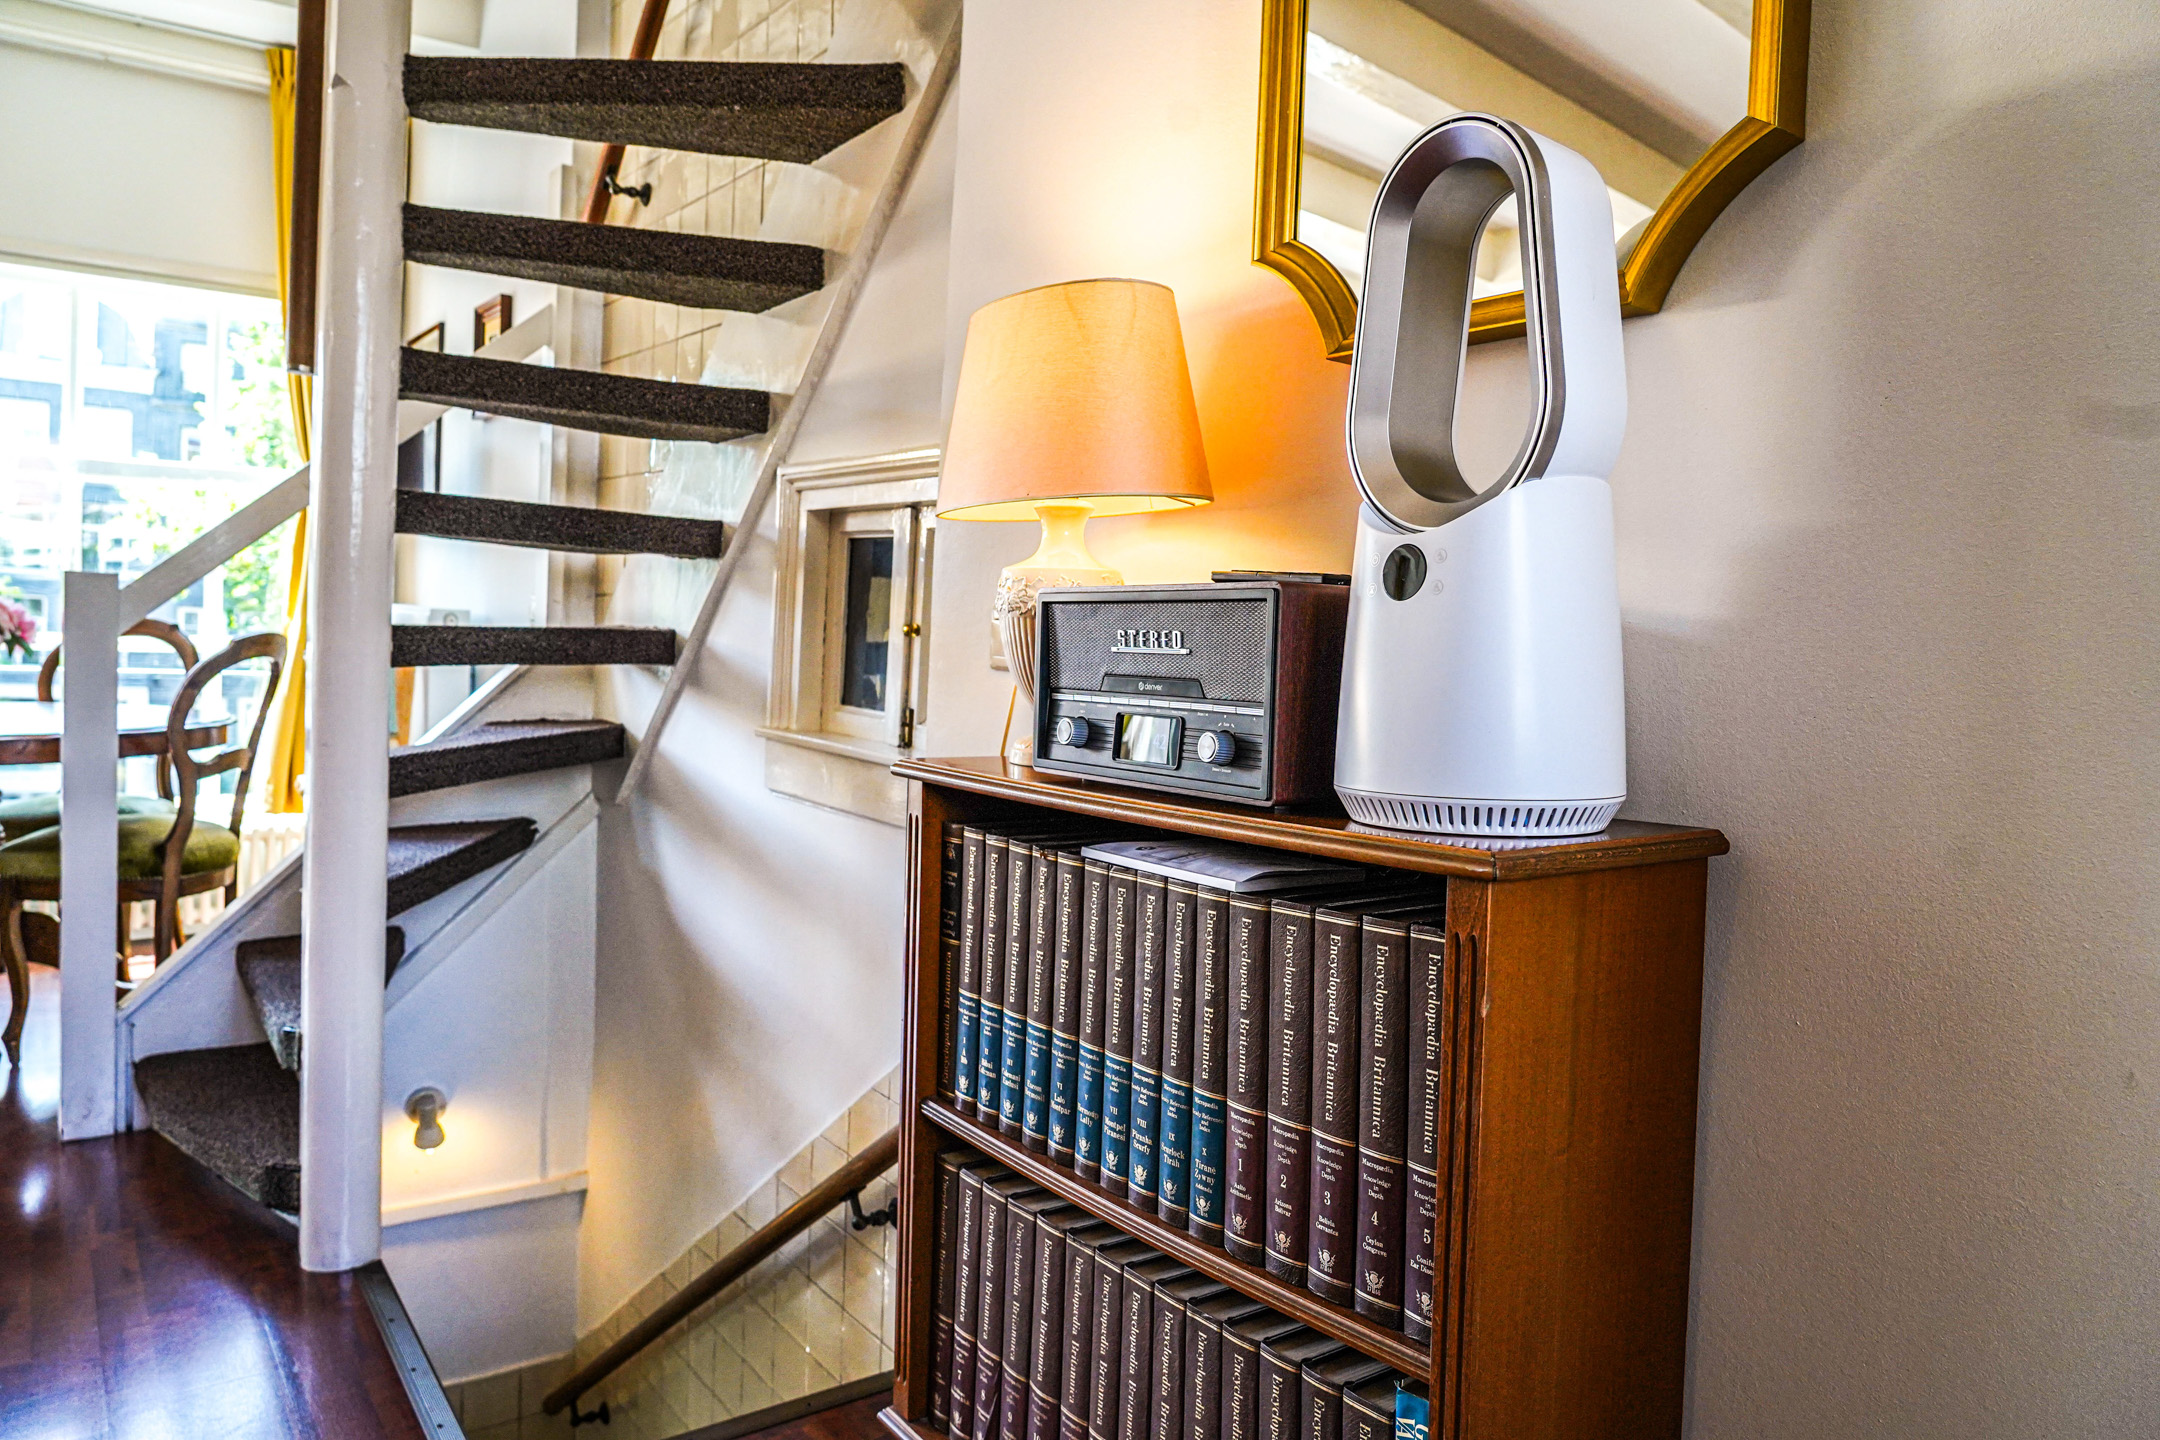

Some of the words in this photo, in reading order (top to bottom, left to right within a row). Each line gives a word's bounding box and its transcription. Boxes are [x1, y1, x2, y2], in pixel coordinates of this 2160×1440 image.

[1117, 629, 1183, 649] STEREO
[1144, 682, 1163, 691] denver
[964, 923, 974, 983] Britannica
[985, 932, 996, 993] Britannica
[1009, 941, 1020, 1003] Britannica
[1033, 949, 1045, 1013] Britannica
[1058, 959, 1069, 1023] Britannica
[1085, 968, 1096, 1034] Britannica
[1112, 976, 1124, 1044] Britannica
[1141, 986, 1152, 1056] Britannica
[1170, 997, 1182, 1067] Britannica
[1201, 1006, 1214, 1079] Britannica
[1238, 1018, 1250, 1093] Britannica
[1281, 1028, 1294, 1107] Britannica
[1325, 1040, 1339, 1122] Britannica
[1371, 1054, 1387, 1139] Britannica
[1168, 1132, 1175, 1142] IX
[1423, 1067, 1439, 1154] Britannica
[1202, 1147, 1207, 1156] X
[1237, 1158, 1243, 1172] 1
[1277, 1154, 1291, 1166] Depth
[1280, 1173, 1287, 1189] 2
[1316, 1155, 1342, 1171] Knowledge
[1321, 1170, 1336, 1182] Depth
[1362, 1172, 1391, 1188] Knowledge
[1324, 1190, 1331, 1205] 3
[1368, 1188, 1384, 1201] Depth
[1371, 1210, 1379, 1226] 4
[1413, 1189, 1436, 1205] Knowled
[1425, 1201, 1431, 1210] in
[1365, 1235, 1384, 1249] Ceylon
[1410, 1259, 1420, 1270] Ear
[1423, 1228, 1431, 1244] 5
[959, 1264, 969, 1322] Britannica
[983, 1280, 993, 1340] Britannica
[1010, 1301, 1020, 1361] Britannica
[1037, 1319, 1049, 1382] Britannica
[1069, 1339, 1080, 1403] Britannica
[1097, 1358, 1109, 1426] Britannica
[1126, 1380, 1137, 1440] Britannic
[1159, 1401, 1170, 1440] Britan
